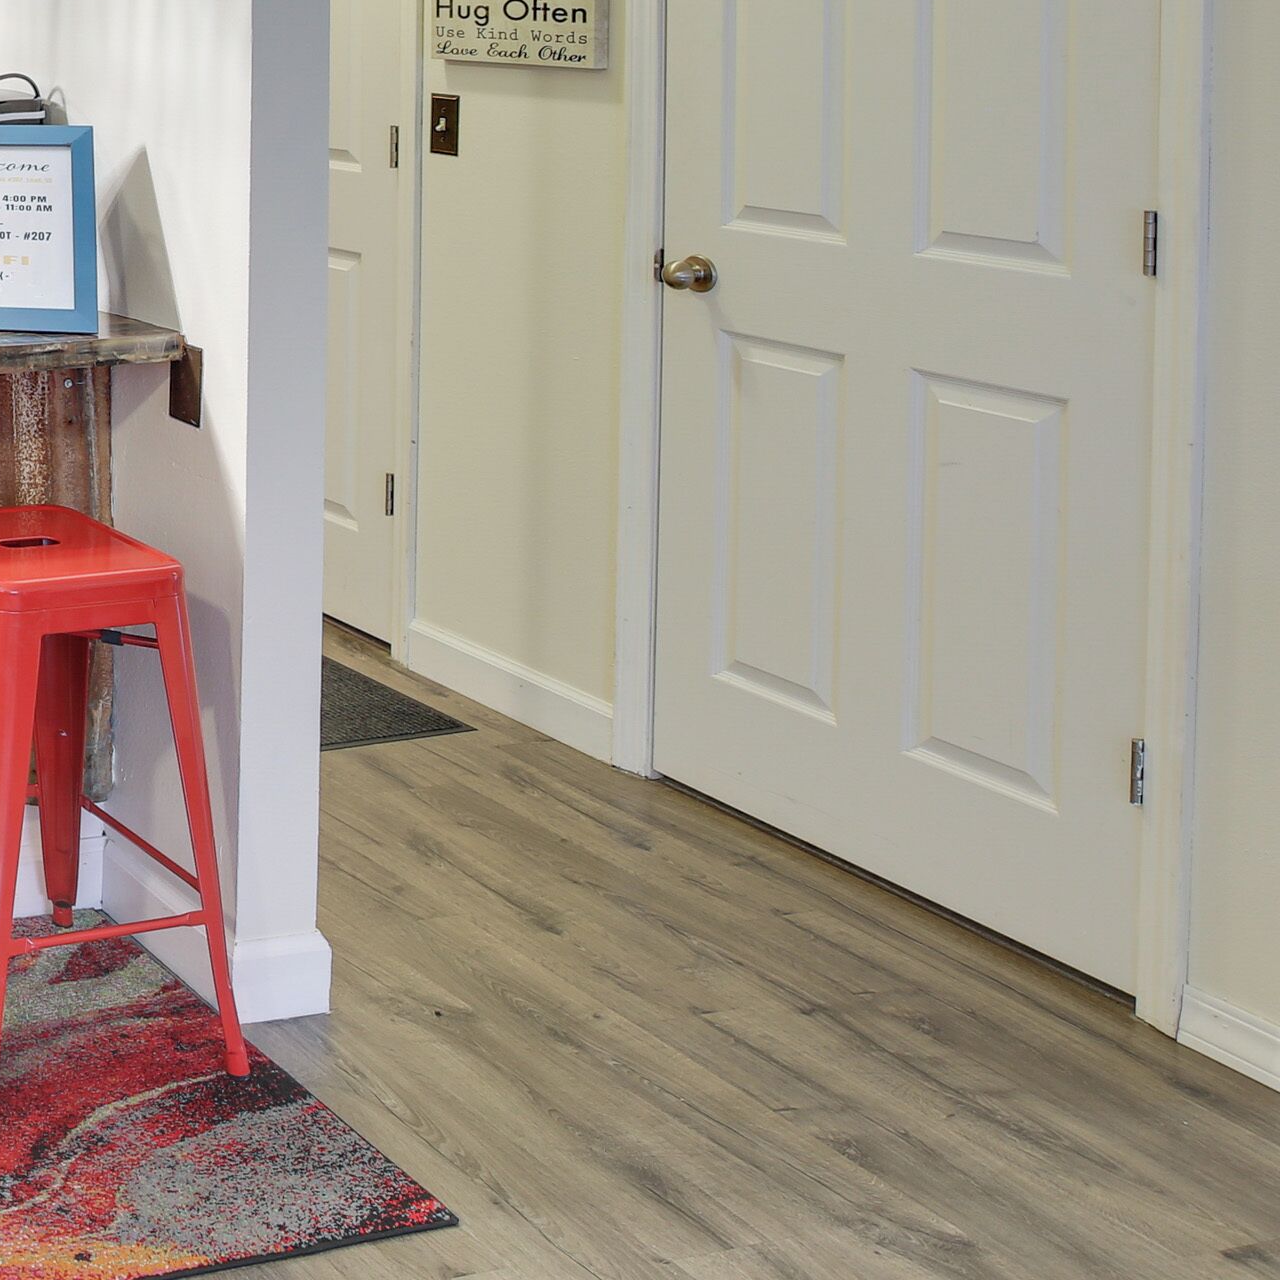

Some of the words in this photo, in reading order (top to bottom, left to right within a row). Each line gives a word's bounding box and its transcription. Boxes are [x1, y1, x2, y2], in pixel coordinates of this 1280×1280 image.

[436, 26, 465, 39] Use
[476, 28, 519, 41] Kind
[531, 30, 588, 45] Words
[436, 40, 478, 56] Love
[487, 42, 530, 59] Each
[538, 45, 586, 62] Other
[30, 195, 47, 203] PM
[36, 204, 53, 212] AM
[23, 231, 52, 241] #207
